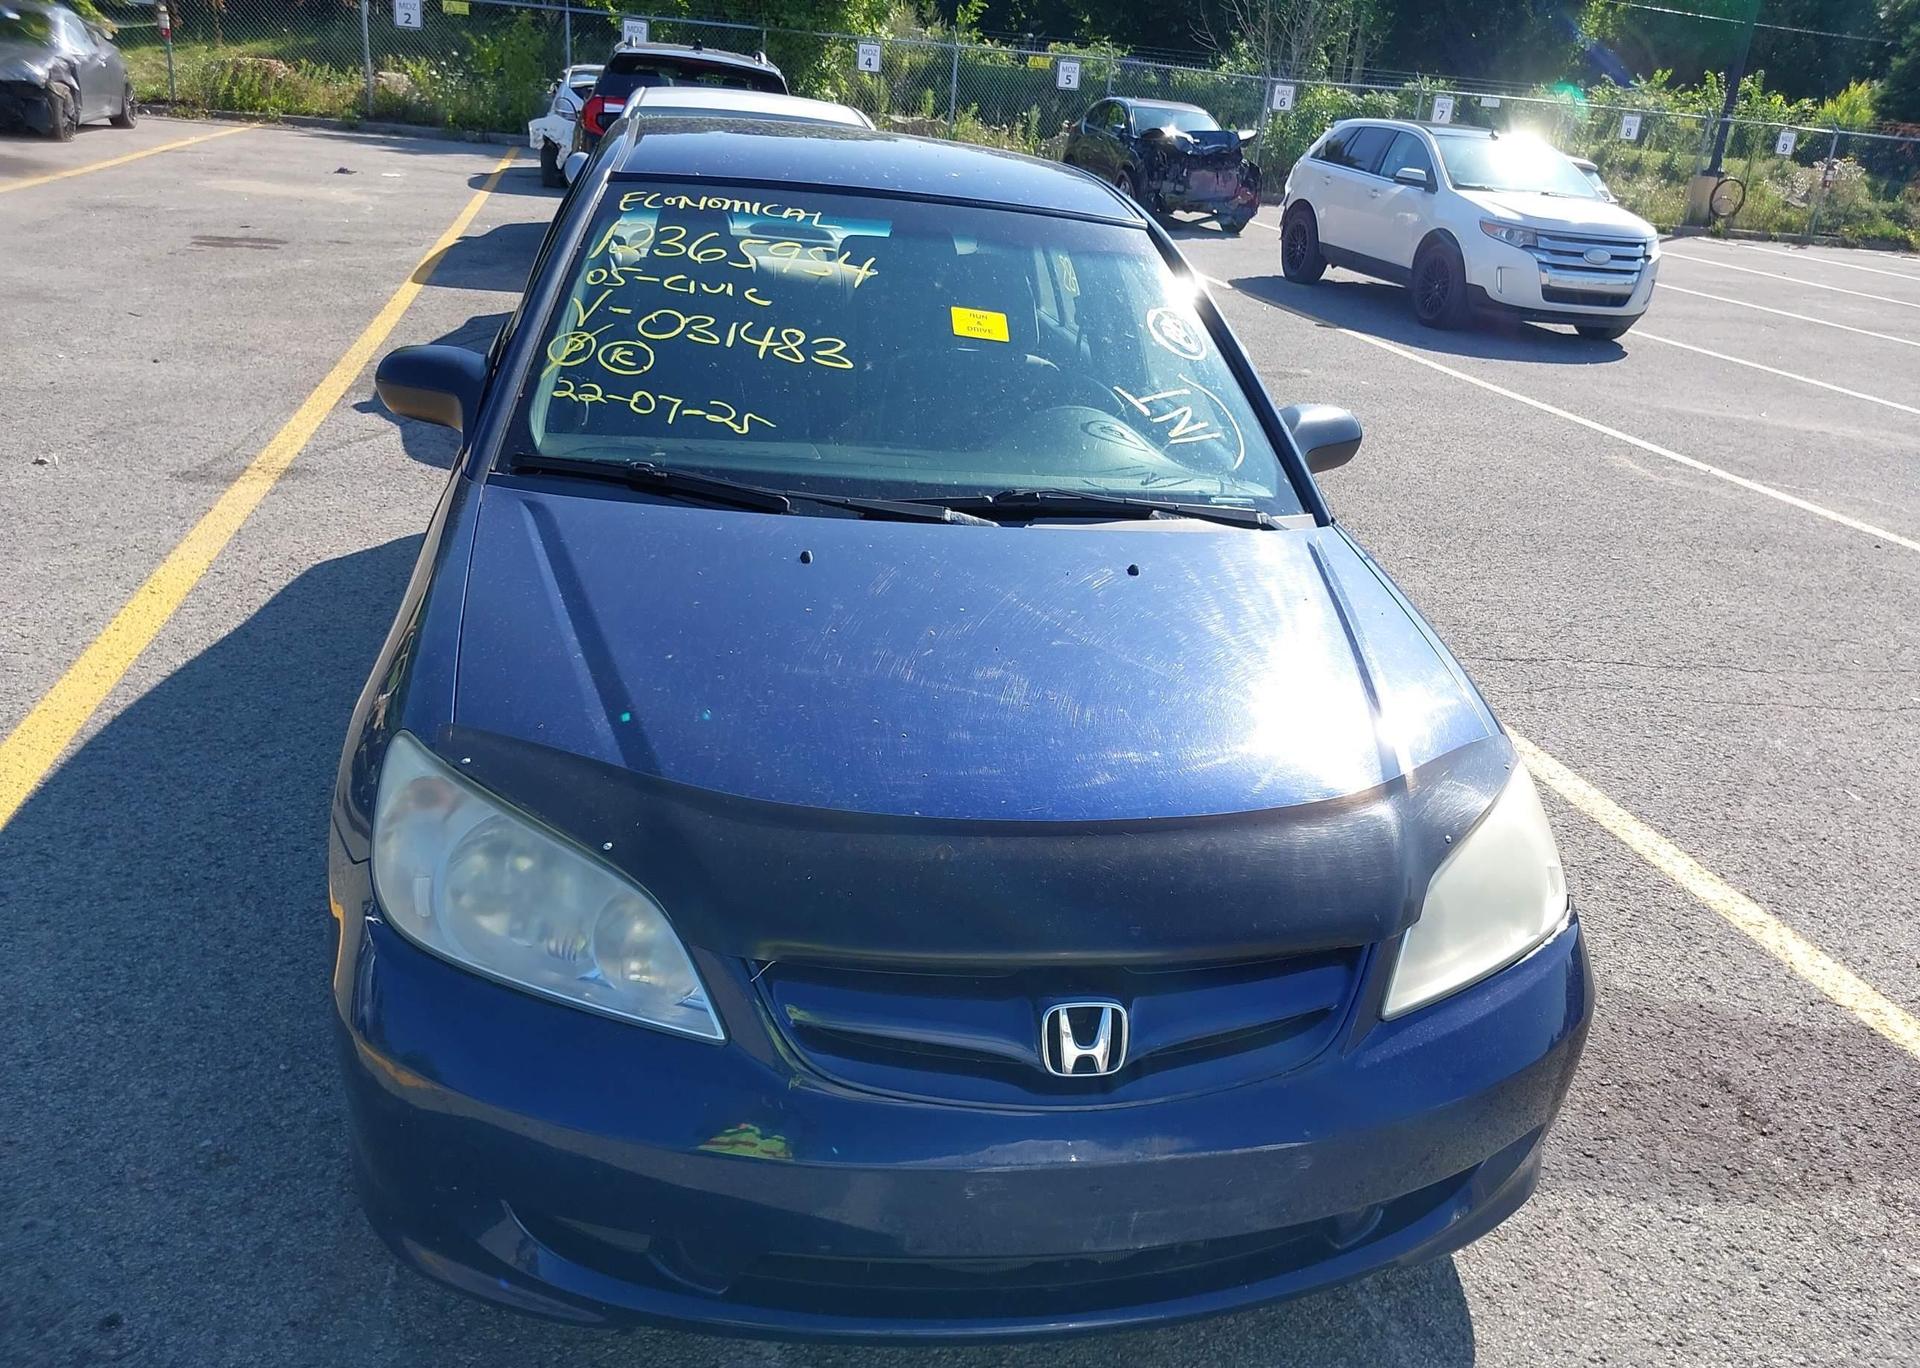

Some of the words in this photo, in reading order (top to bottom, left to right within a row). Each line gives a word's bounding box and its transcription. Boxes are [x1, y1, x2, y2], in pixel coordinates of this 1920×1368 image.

[404, 13, 412, 24] 2
[865, 57, 872, 68] 4
[1065, 75, 1072, 85] 5
[1279, 97, 1286, 107] 6
[1438, 110, 1445, 120] 7
[1625, 128, 1632, 137] 8
[1781, 143, 1788, 152] 9
